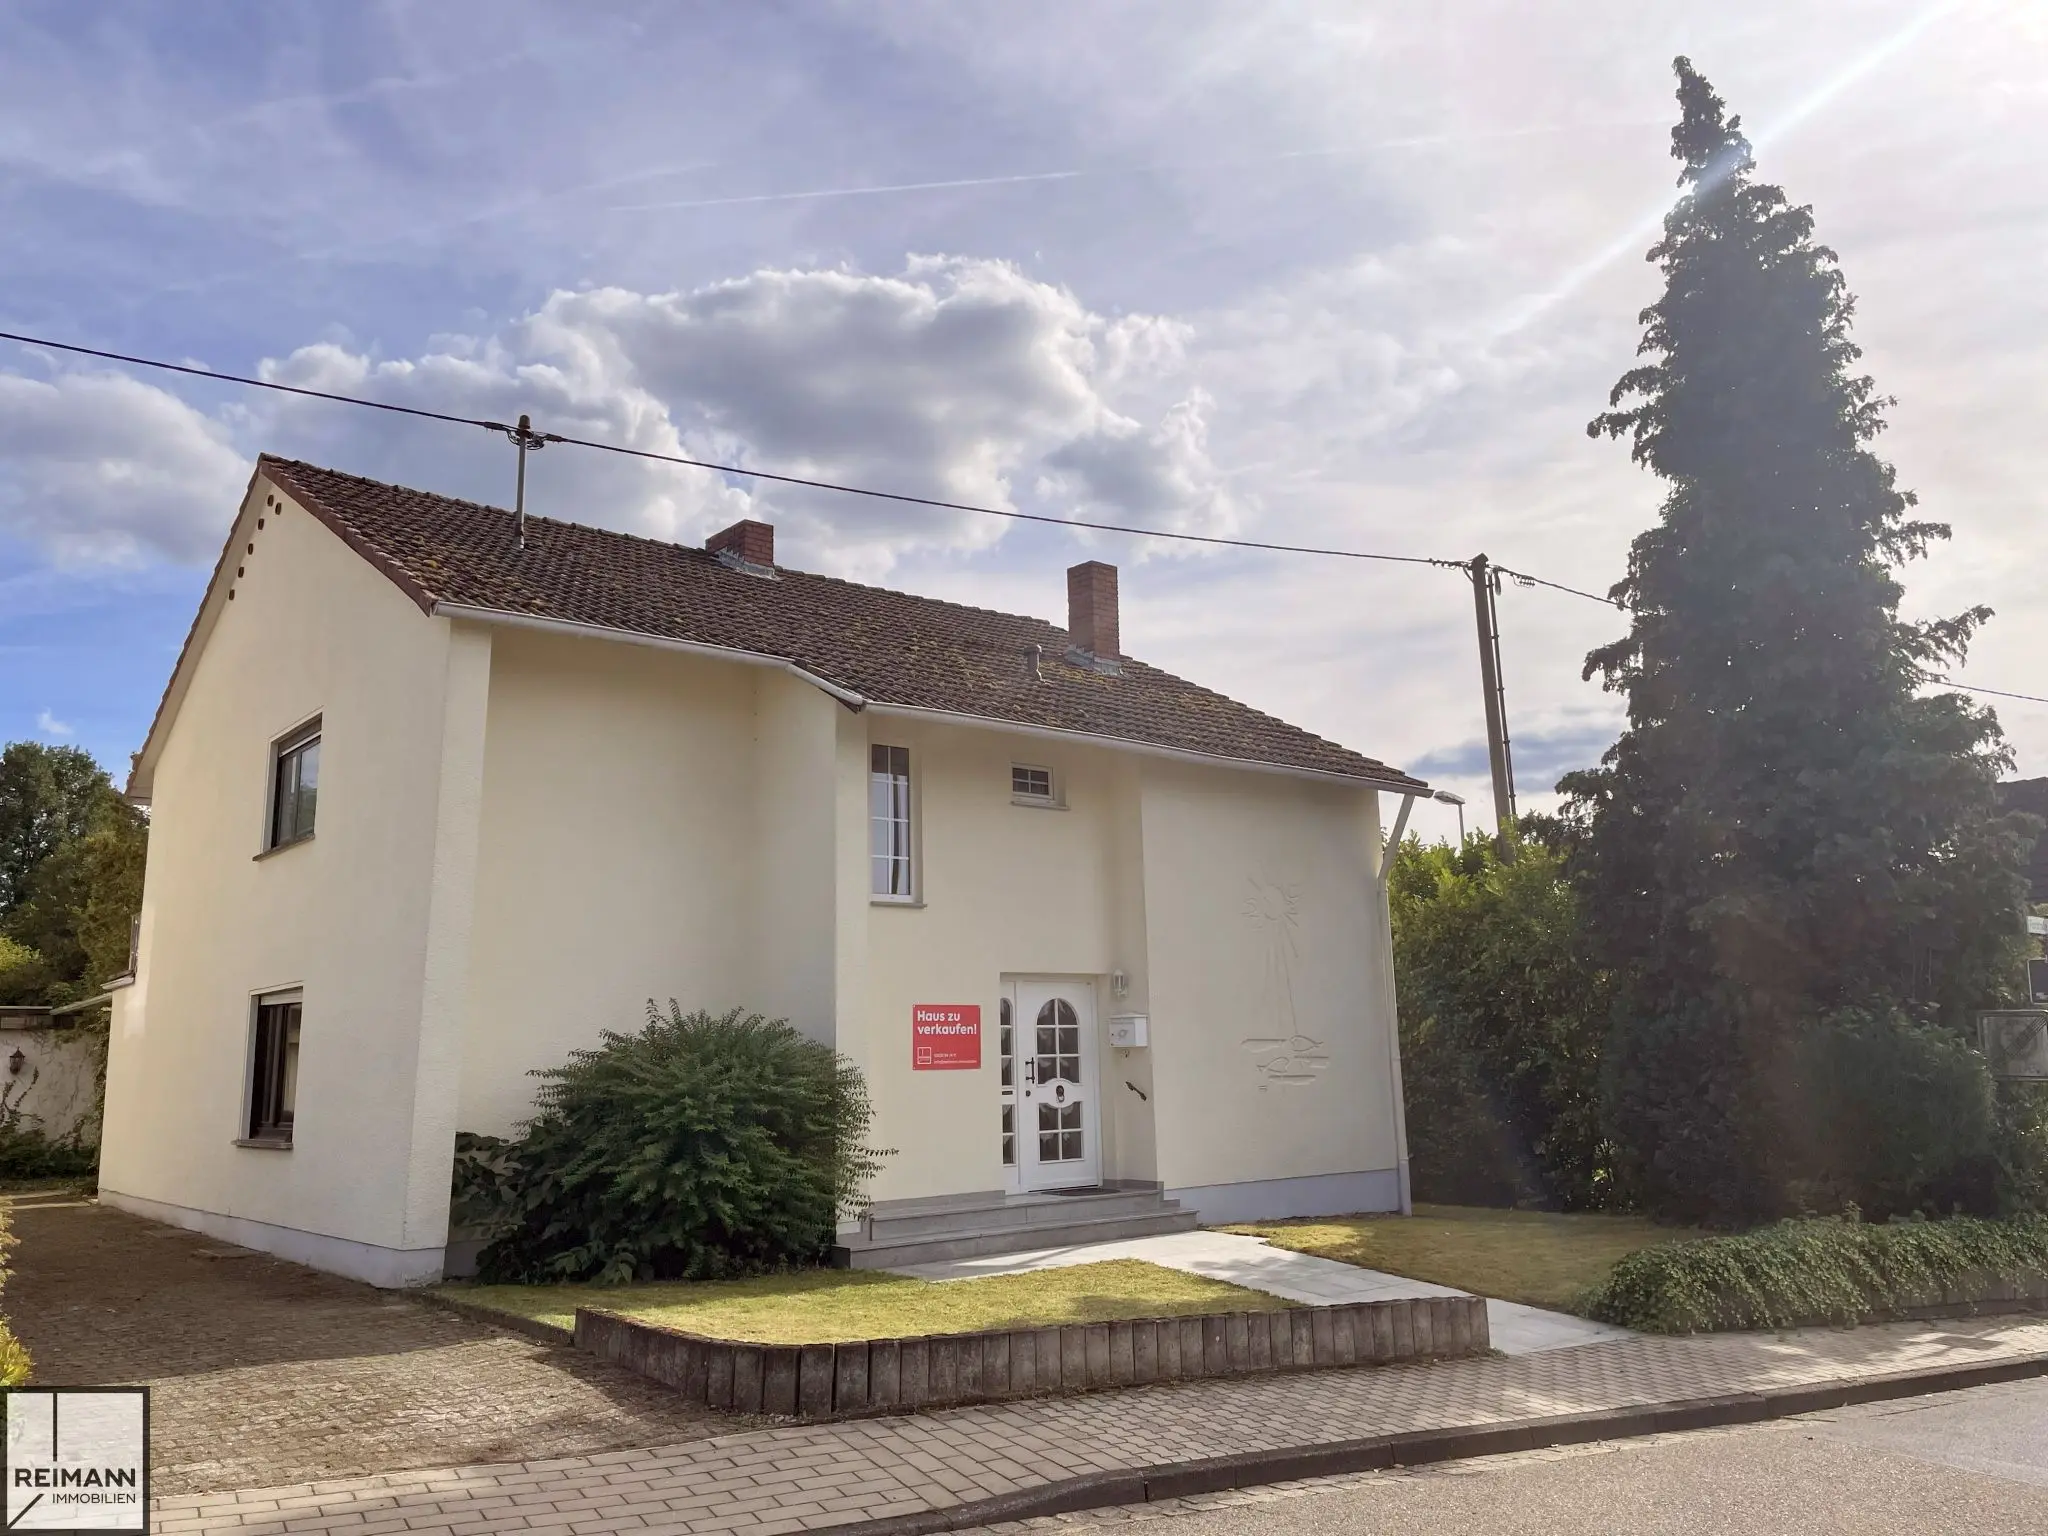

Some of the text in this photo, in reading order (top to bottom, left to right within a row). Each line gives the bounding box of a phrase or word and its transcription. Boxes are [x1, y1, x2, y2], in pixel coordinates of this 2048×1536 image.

[917, 1010, 960, 1022] Haus zu
[917, 1023, 977, 1035] verkaufen!
